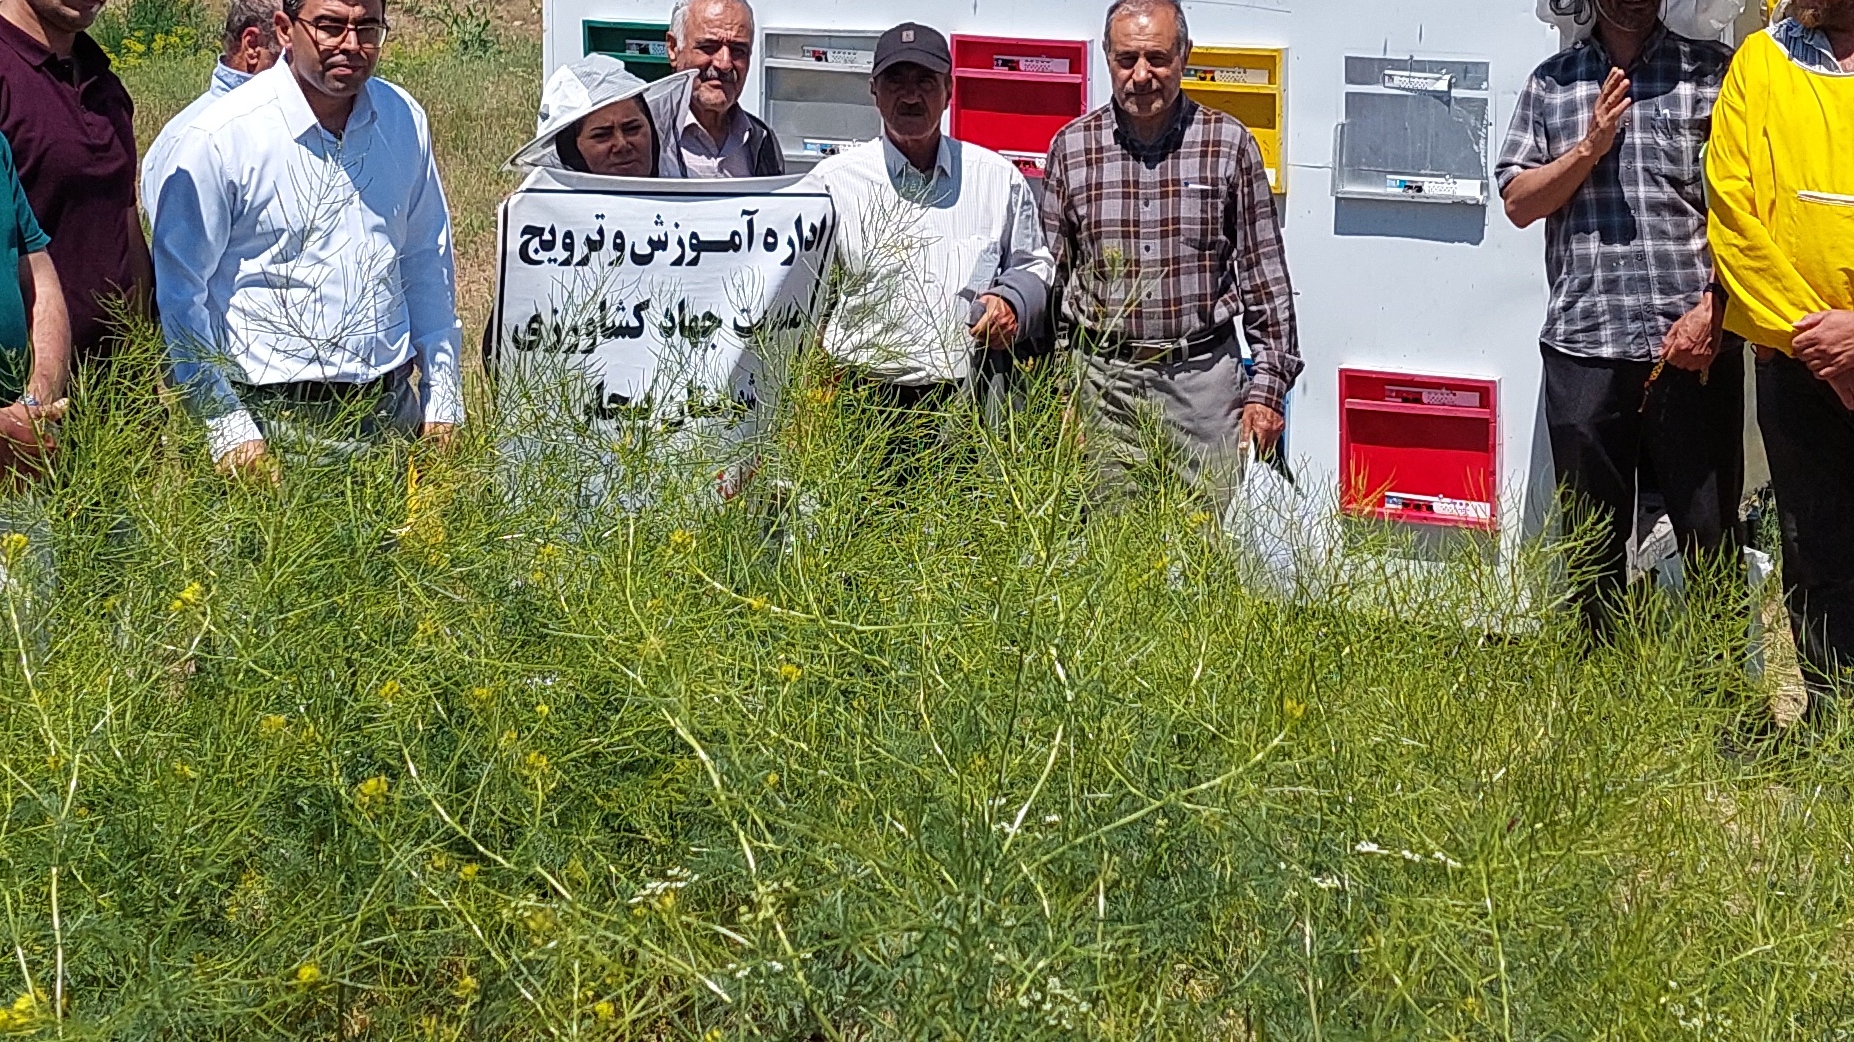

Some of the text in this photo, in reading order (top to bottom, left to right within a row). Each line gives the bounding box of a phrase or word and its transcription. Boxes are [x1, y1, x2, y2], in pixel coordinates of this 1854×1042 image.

[630, 208, 759, 266] آموزش
[763, 212, 827, 266] اداره
[511, 297, 651, 354] کشاورزی
[659, 296, 723, 349] جهاد
